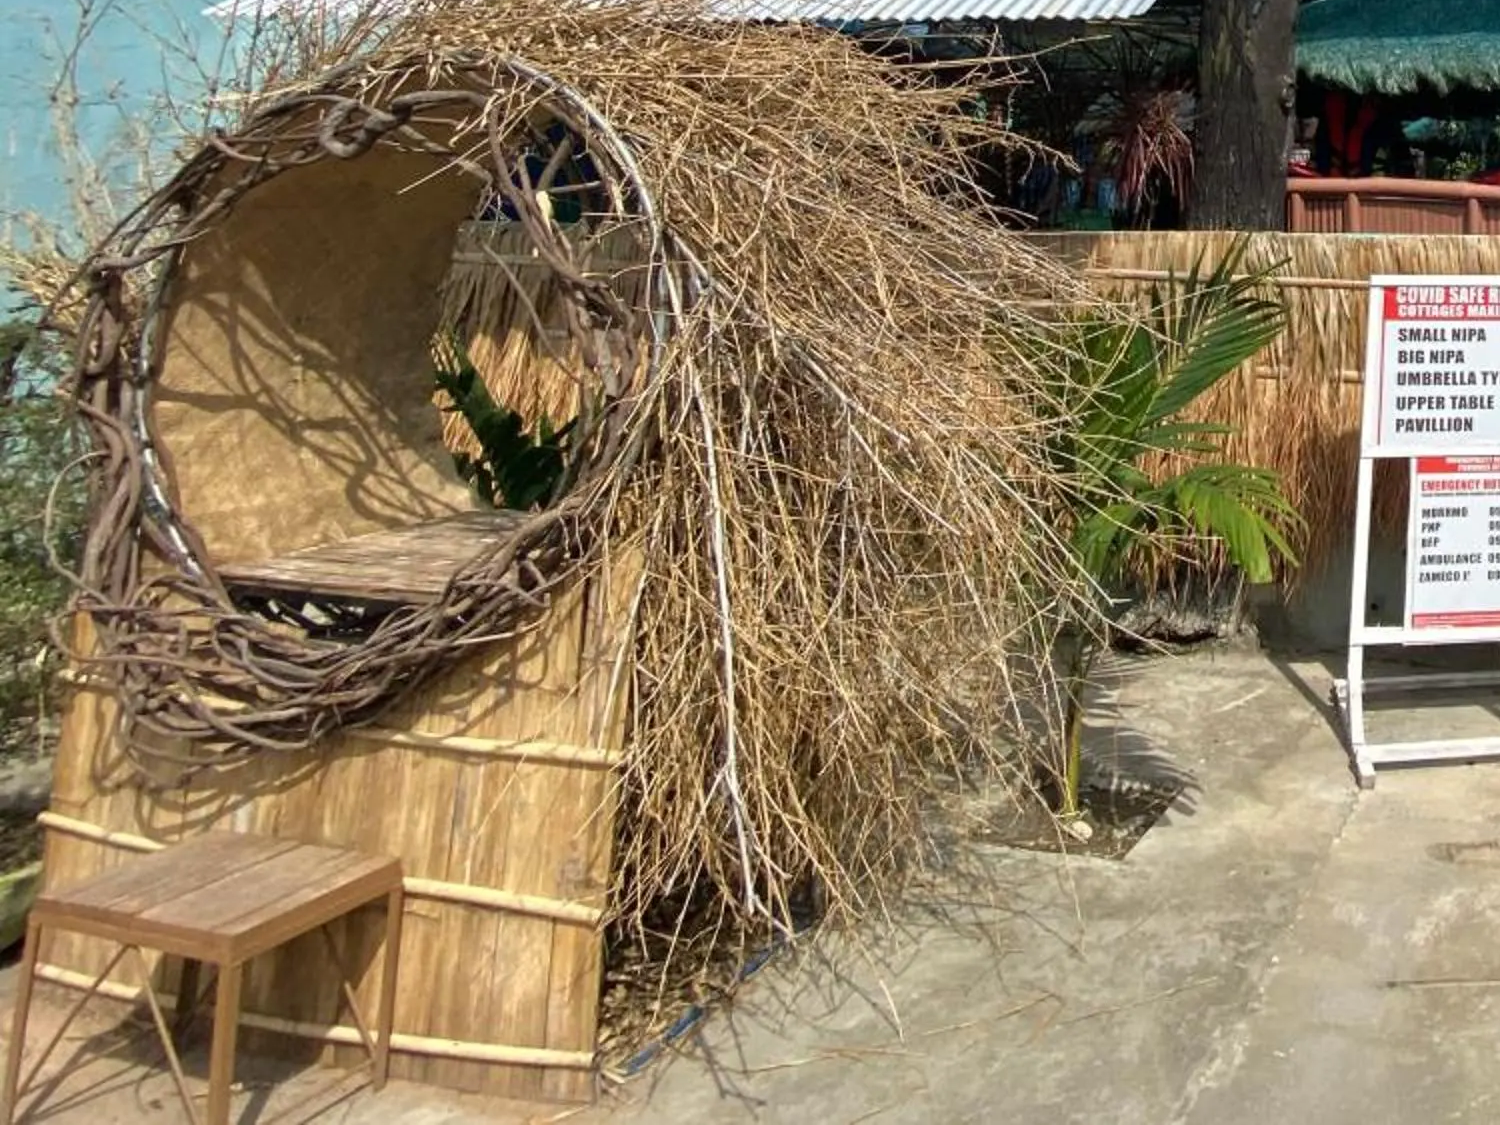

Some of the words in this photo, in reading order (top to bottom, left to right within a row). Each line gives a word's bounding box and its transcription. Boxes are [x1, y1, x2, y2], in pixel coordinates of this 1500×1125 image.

[1396, 286, 1445, 304] COVID
[1449, 286, 1486, 304] SAFE
[1397, 304, 1465, 318] COTTAGES
[1397, 328, 1448, 342] SMALL
[1451, 328, 1487, 342] NIPA
[1398, 349, 1425, 364] BIG
[1429, 349, 1465, 364] NIPA
[1397, 371, 1477, 386] UMBRELLA
[1396, 395, 1445, 410] UPPER
[1450, 395, 1495, 410] TABLE
[1395, 418, 1474, 432] PAVILLION
[1419, 553, 1482, 566] AMBULANCE
